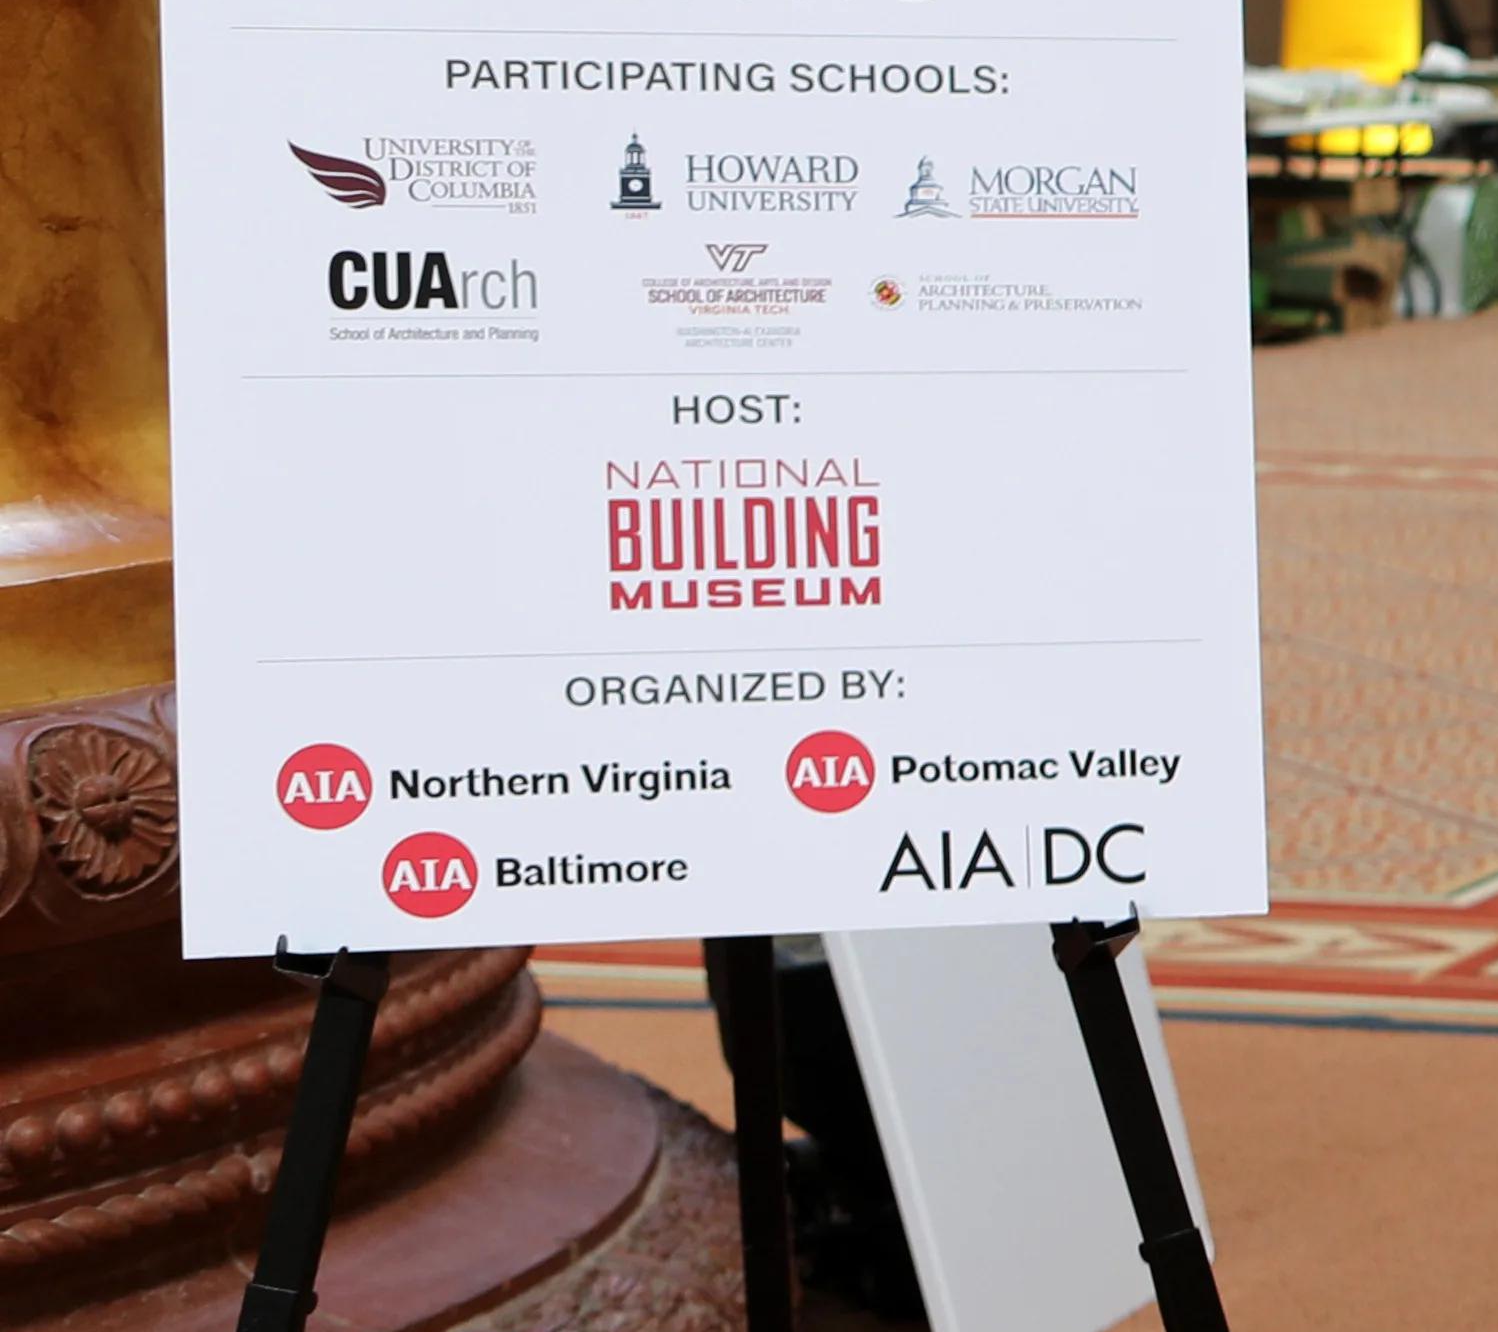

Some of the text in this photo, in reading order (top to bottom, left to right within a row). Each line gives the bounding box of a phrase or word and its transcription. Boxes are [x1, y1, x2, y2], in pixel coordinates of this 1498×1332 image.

[446, 59, 1008, 94] PARTICIPATING SCHOOLS:
[362, 137, 514, 161] UNIVERSITY
[388, 156, 537, 181] DISTRICT OF
[685, 154, 859, 183] HOWARD
[969, 166, 1136, 195] MORGAN
[408, 179, 538, 203] COLUMBIA
[686, 190, 858, 212] UNIVERSITY
[967, 196, 1024, 213] STATE
[706, 244, 769, 272] VT
[647, 288, 826, 304] SCHOOL OF ARCHITECTURE
[918, 298, 1005, 311] PLANNING
[1023, 297, 1143, 311] PRESERVATION
[329, 326, 540, 343] School of Architecture and Planning
[673, 394, 800, 425] HOST:
[606, 457, 880, 490] NATIONAL
[607, 495, 880, 572] BUILDING
[610, 576, 881, 610] MUSEUM
[565, 669, 904, 707] ORGANIZED BY:
[283, 759, 731, 804] AIA Northern Virginia
[791, 748, 1181, 788] AIA Potomac Valley
[388, 853, 688, 892] AIA Baltimore
